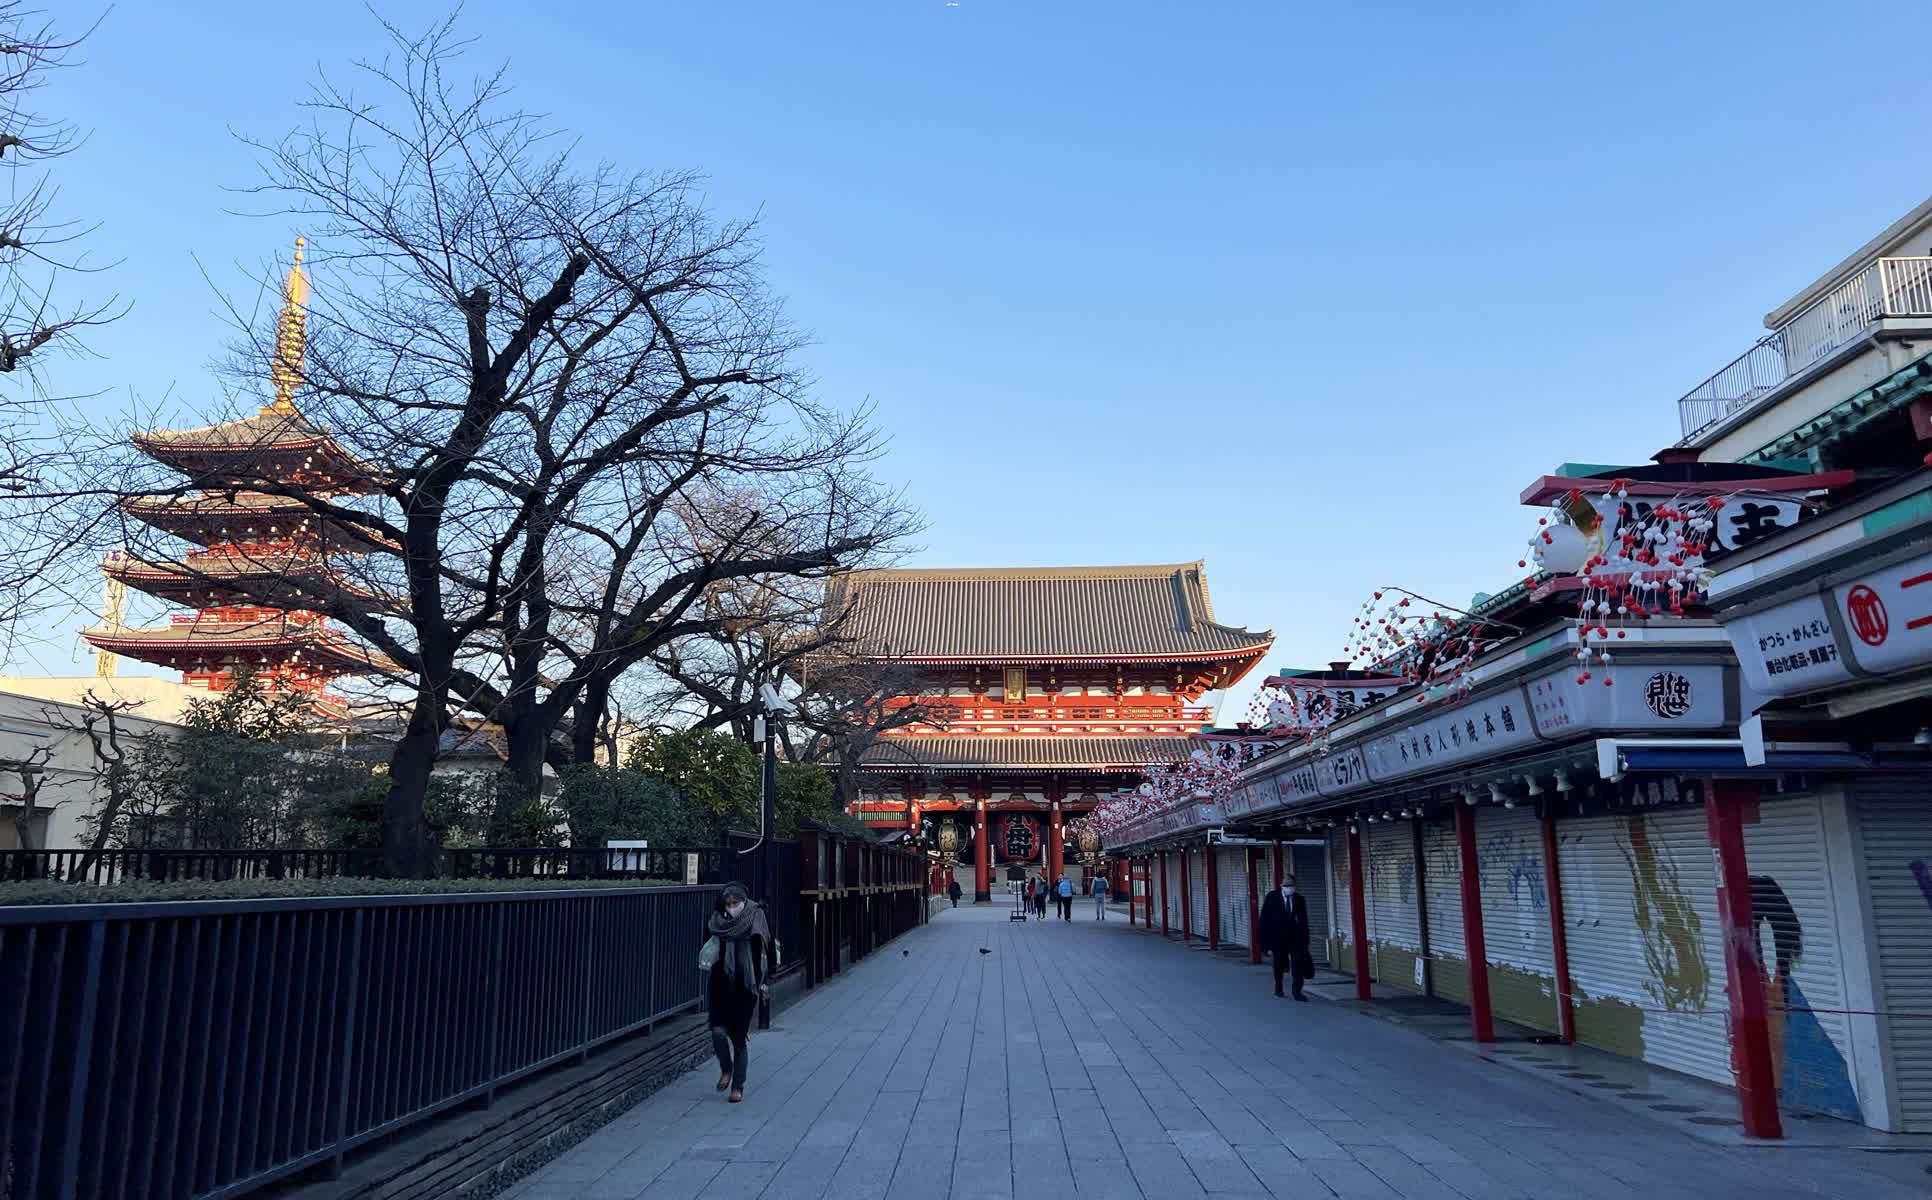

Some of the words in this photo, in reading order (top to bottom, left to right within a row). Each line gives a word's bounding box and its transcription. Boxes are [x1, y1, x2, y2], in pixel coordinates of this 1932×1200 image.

[1758, 619, 1830, 652] かつら・かんざし
[1331, 750, 1363, 786] ヒラノヤ
